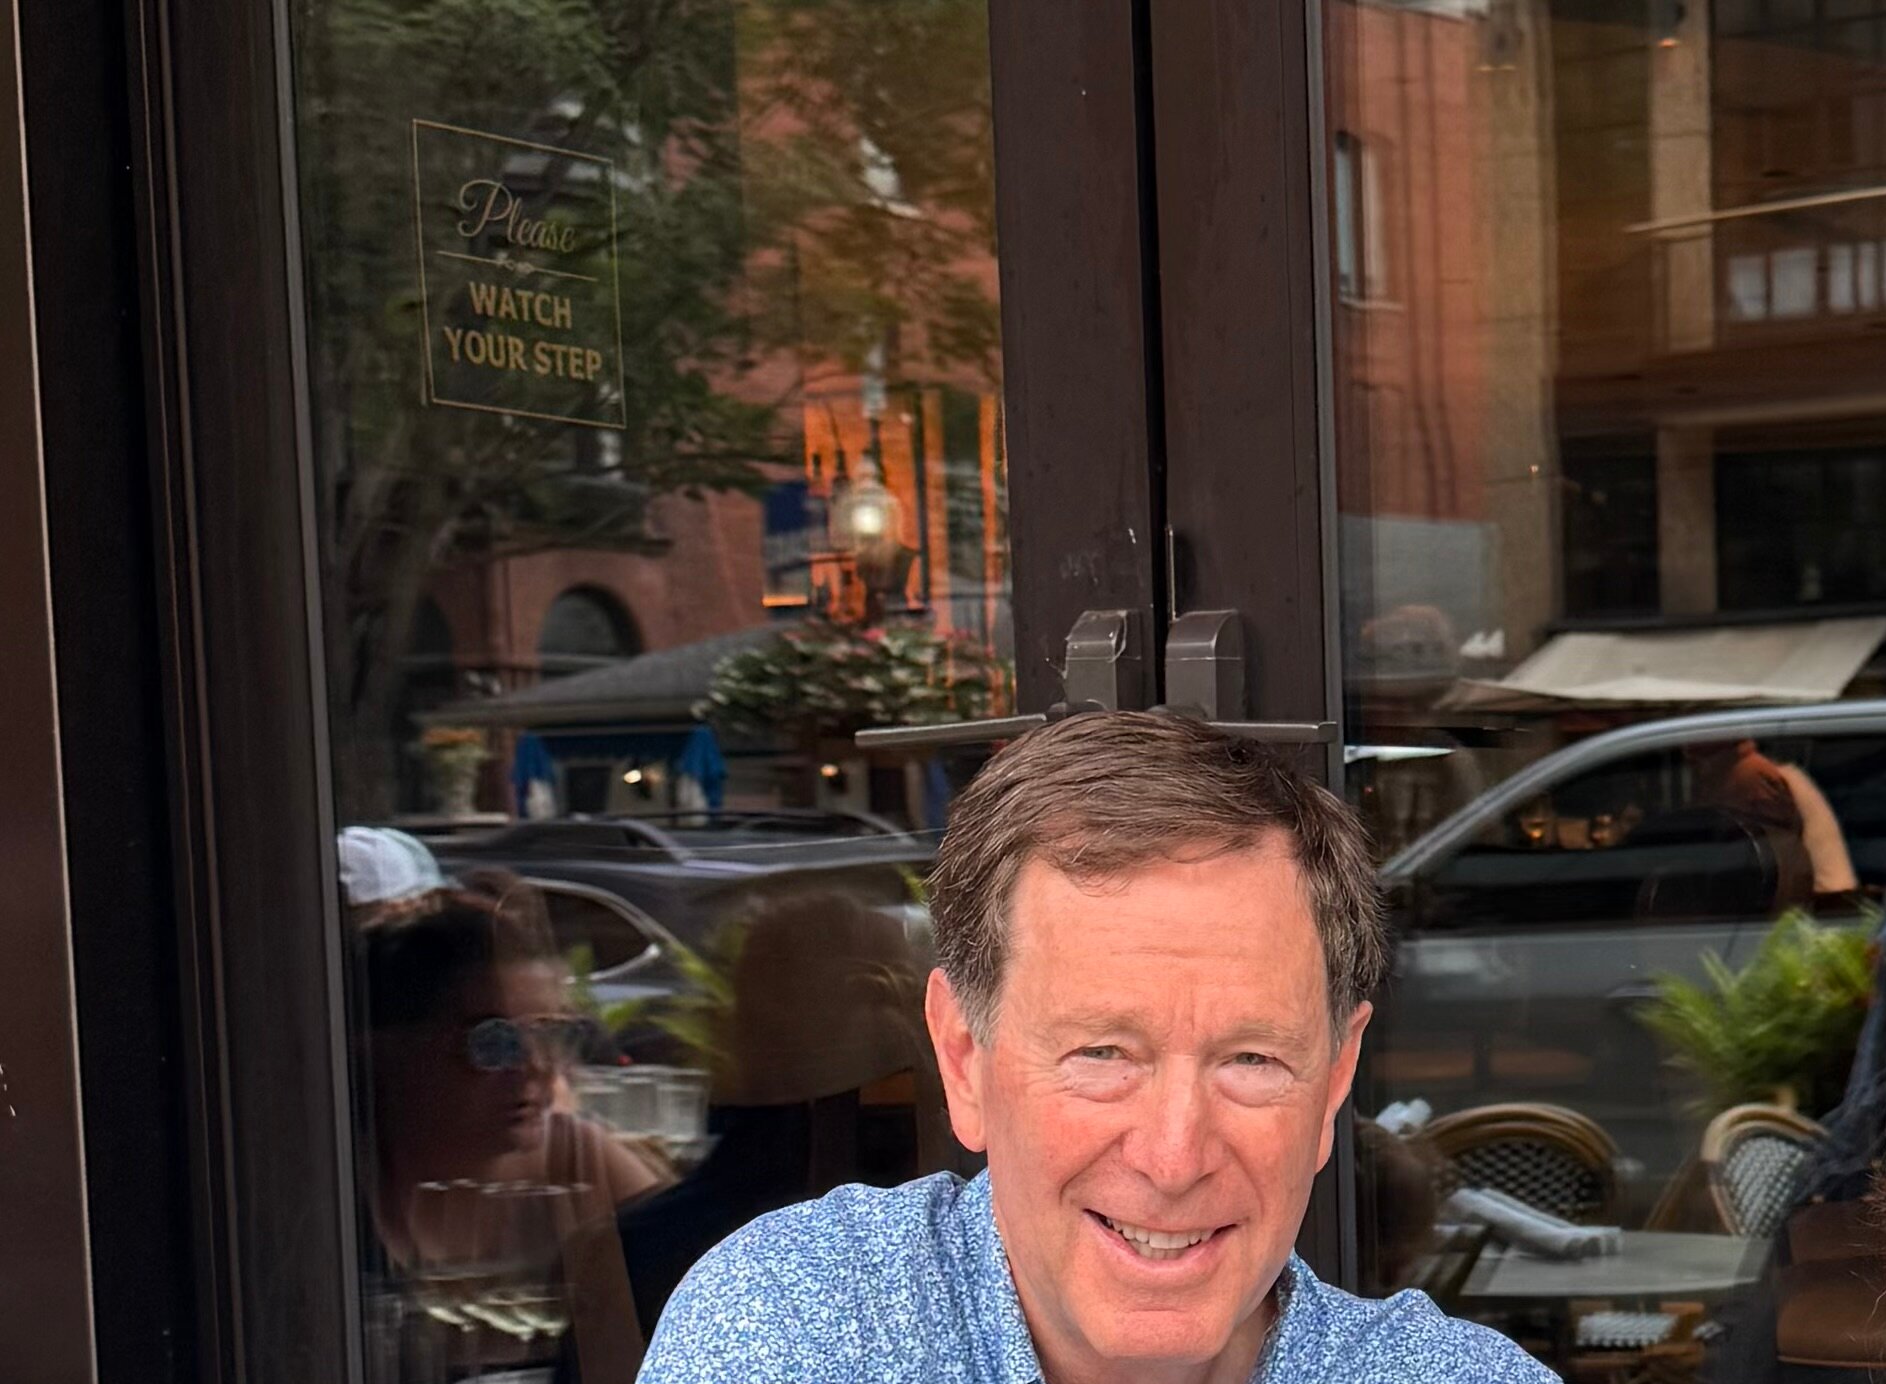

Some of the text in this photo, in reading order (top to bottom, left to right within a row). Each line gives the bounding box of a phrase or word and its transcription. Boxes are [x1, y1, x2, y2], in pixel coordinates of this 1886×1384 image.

[458, 179, 575, 253] Please
[469, 281, 572, 329] WATCH
[444, 326, 602, 381] YOUR STEP
